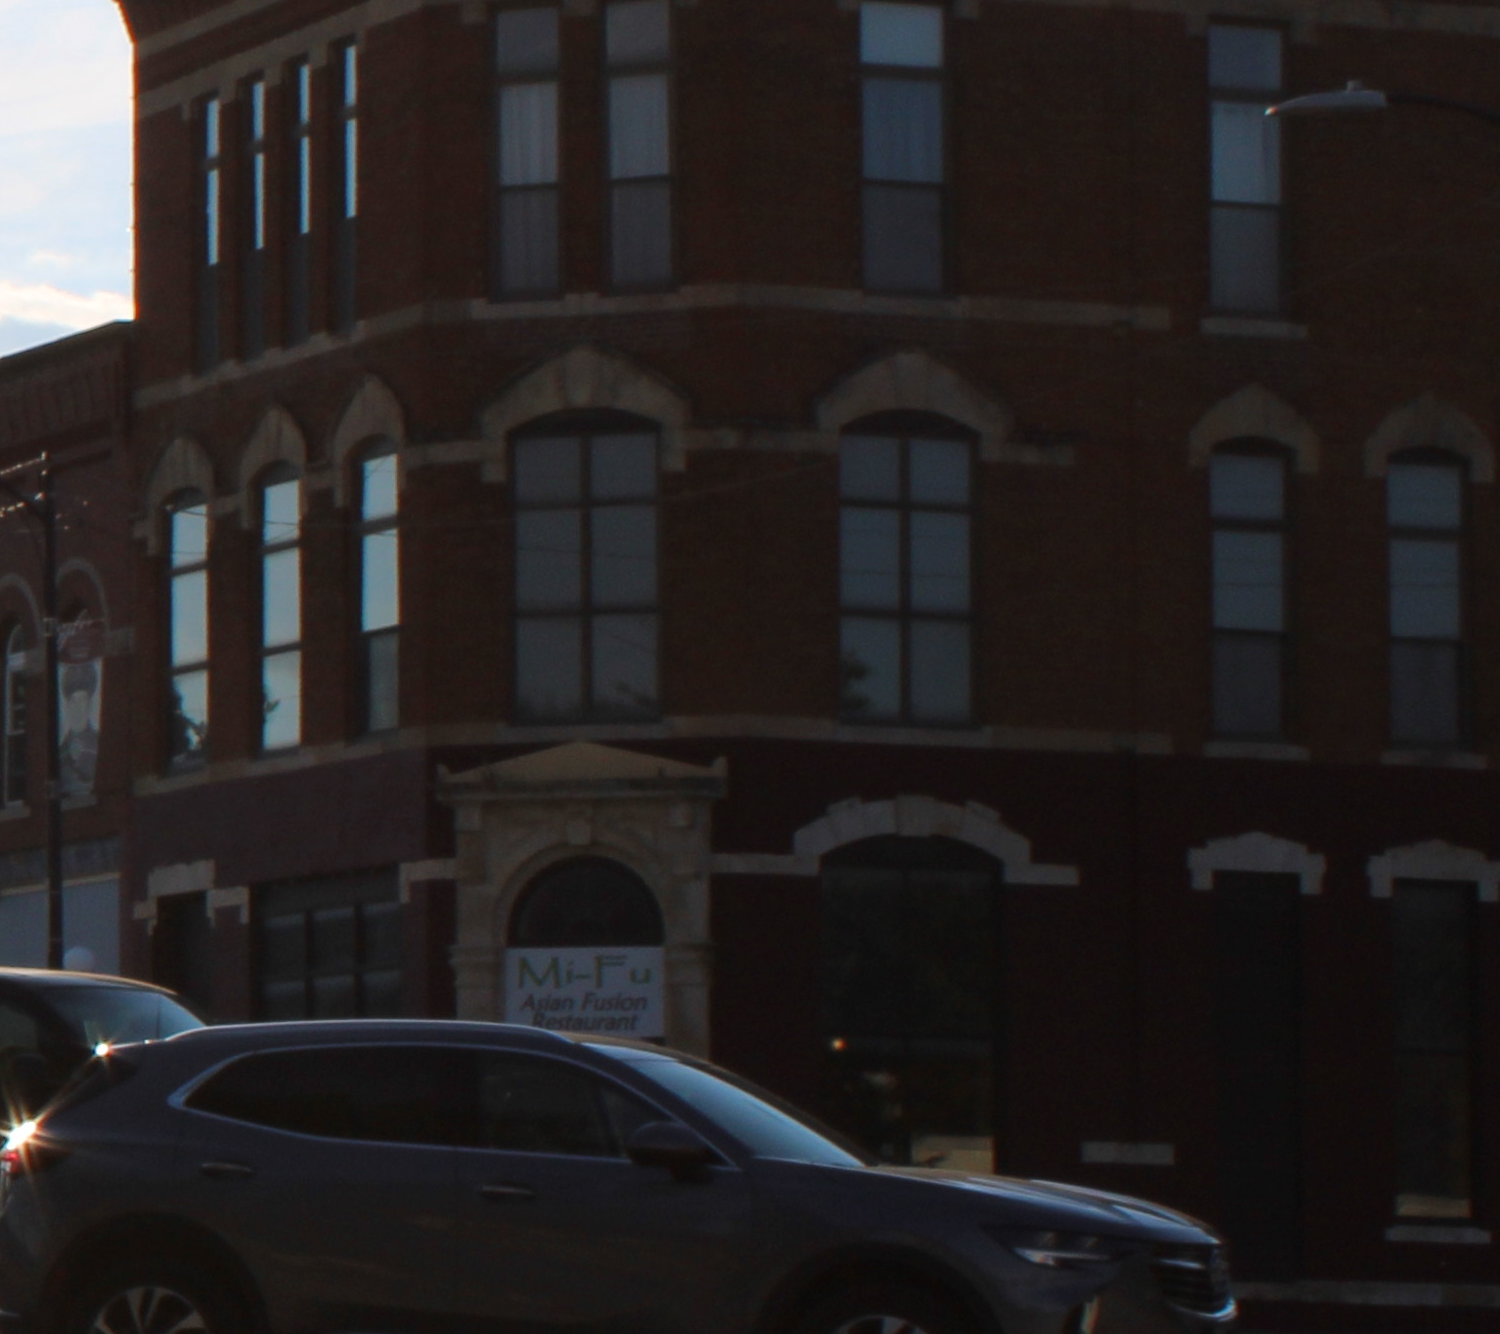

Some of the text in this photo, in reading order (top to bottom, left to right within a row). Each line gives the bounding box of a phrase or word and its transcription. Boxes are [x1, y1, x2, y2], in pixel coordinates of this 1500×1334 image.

[517, 953, 652, 988] Mi-Fu
[520, 992, 648, 1011] Asian Fusion
[532, 1012, 639, 1031] Restaurant
